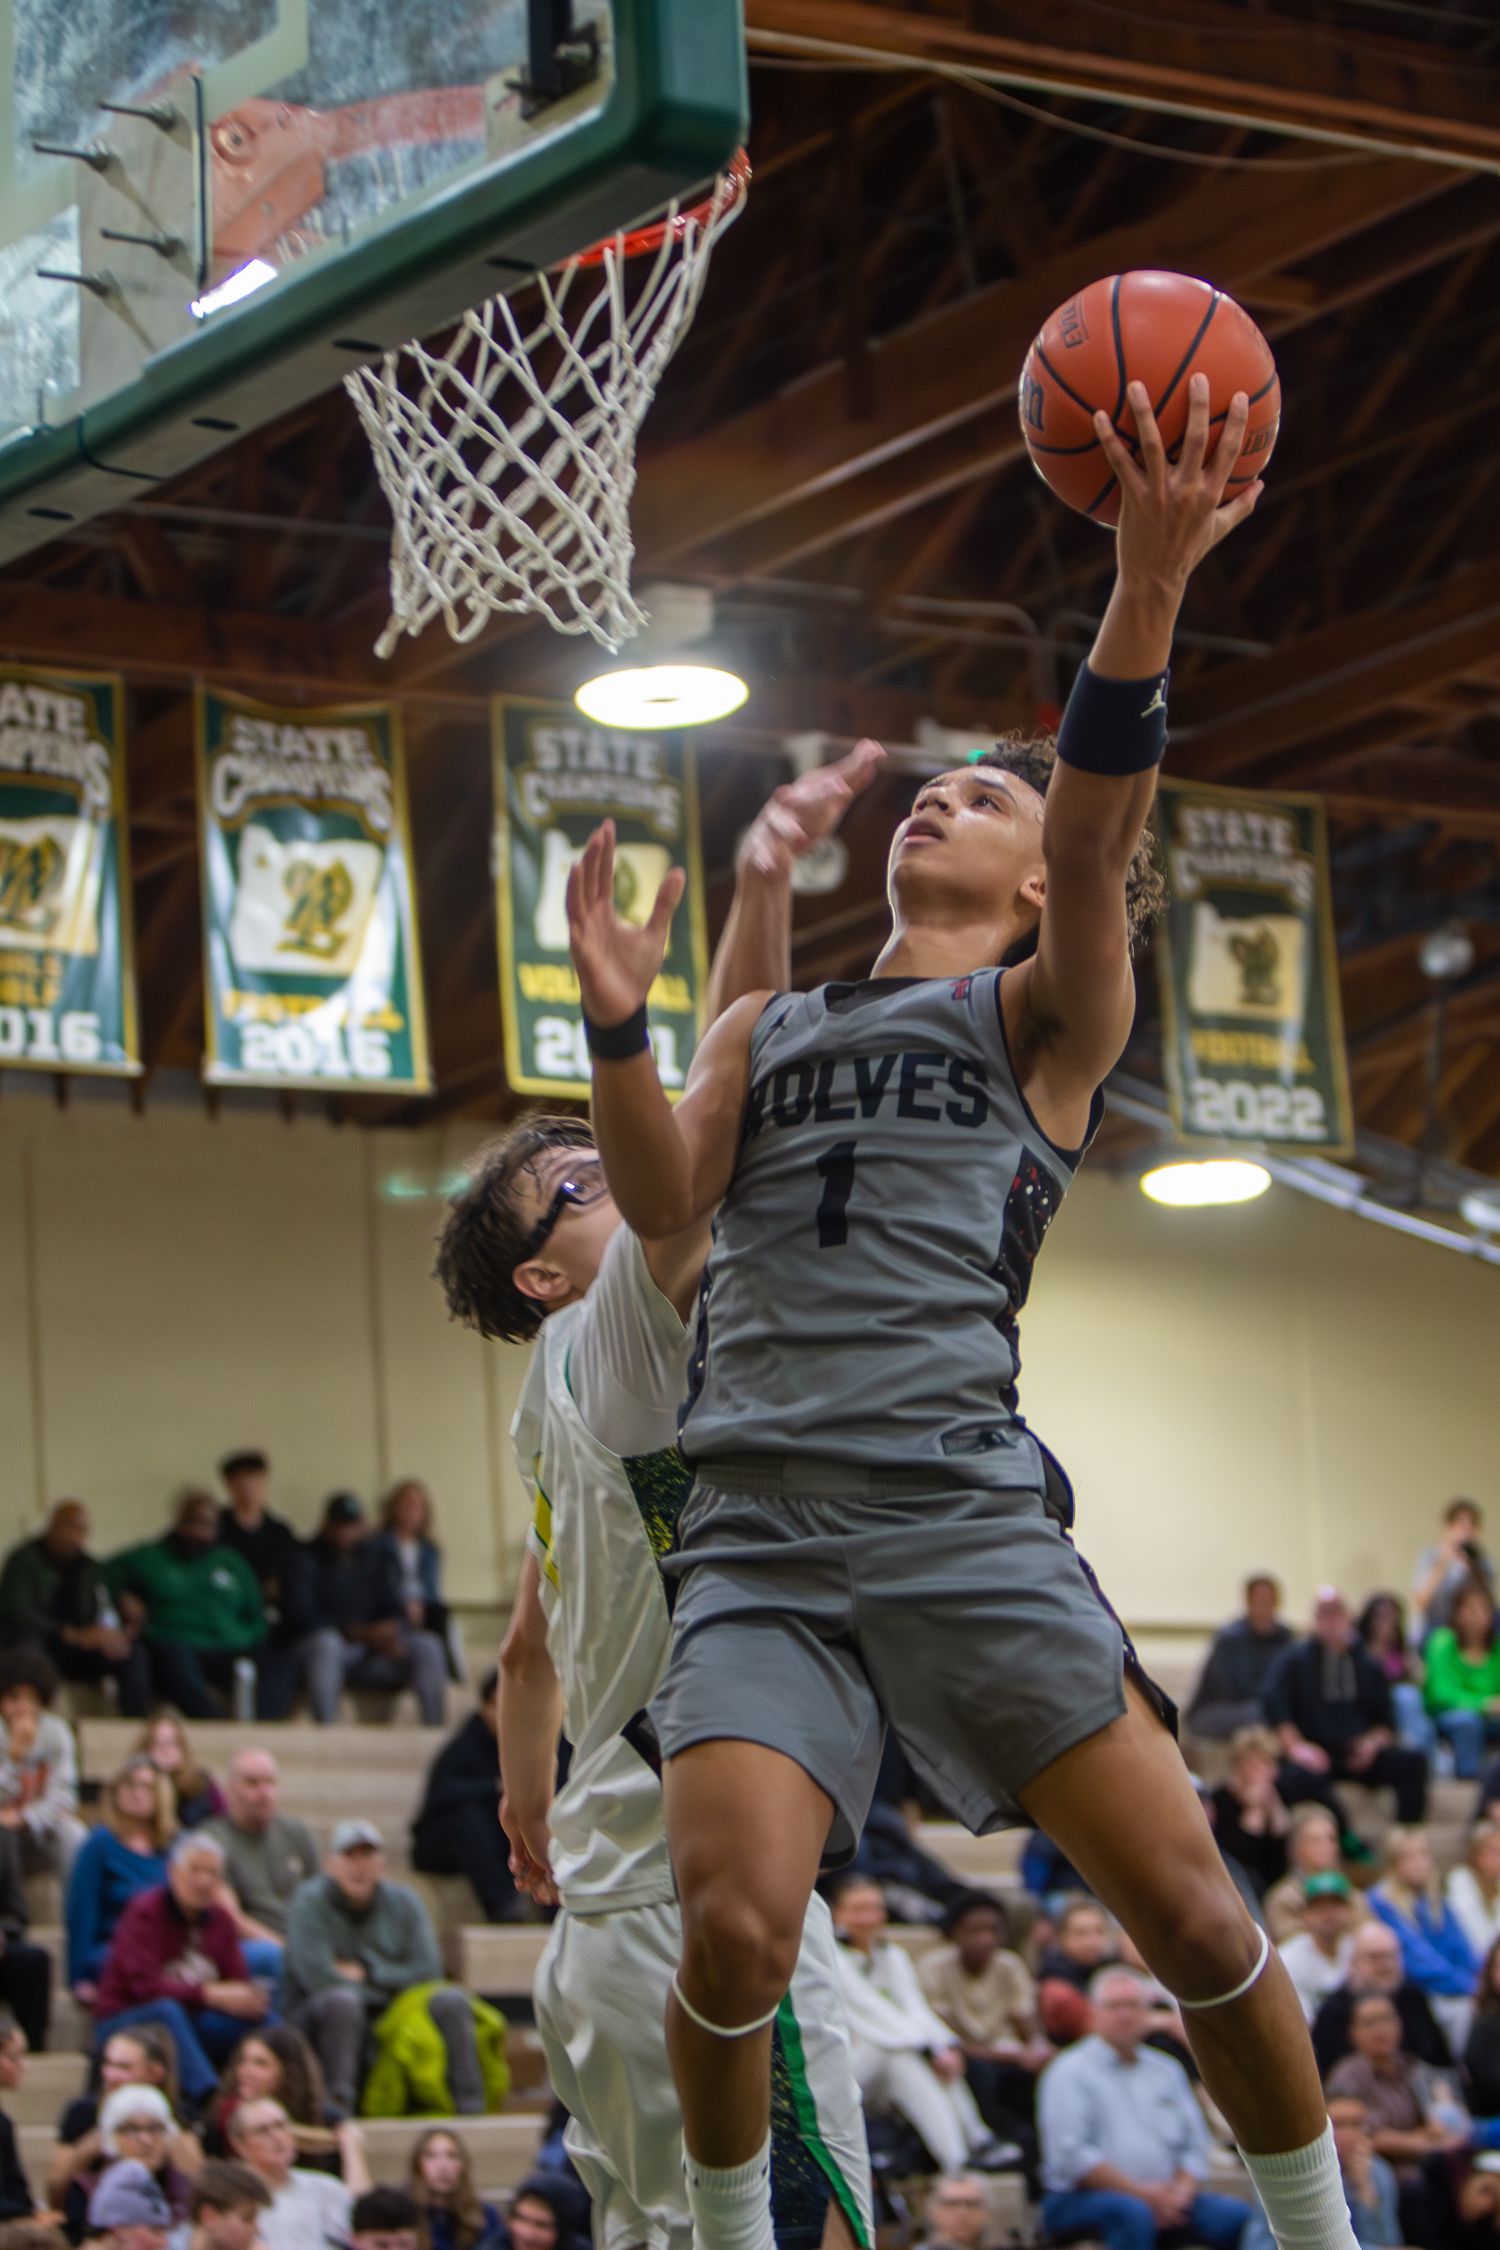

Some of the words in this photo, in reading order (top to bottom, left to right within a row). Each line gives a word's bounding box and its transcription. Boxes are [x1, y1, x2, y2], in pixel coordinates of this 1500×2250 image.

[231, 716, 374, 769] STATE
[534, 728, 662, 780] STATE
[1178, 805, 1296, 857] STATE
[240, 1022, 393, 1079] 2016
[1190, 1076, 1329, 1140] 2022
[815, 1141, 858, 1249] 1
